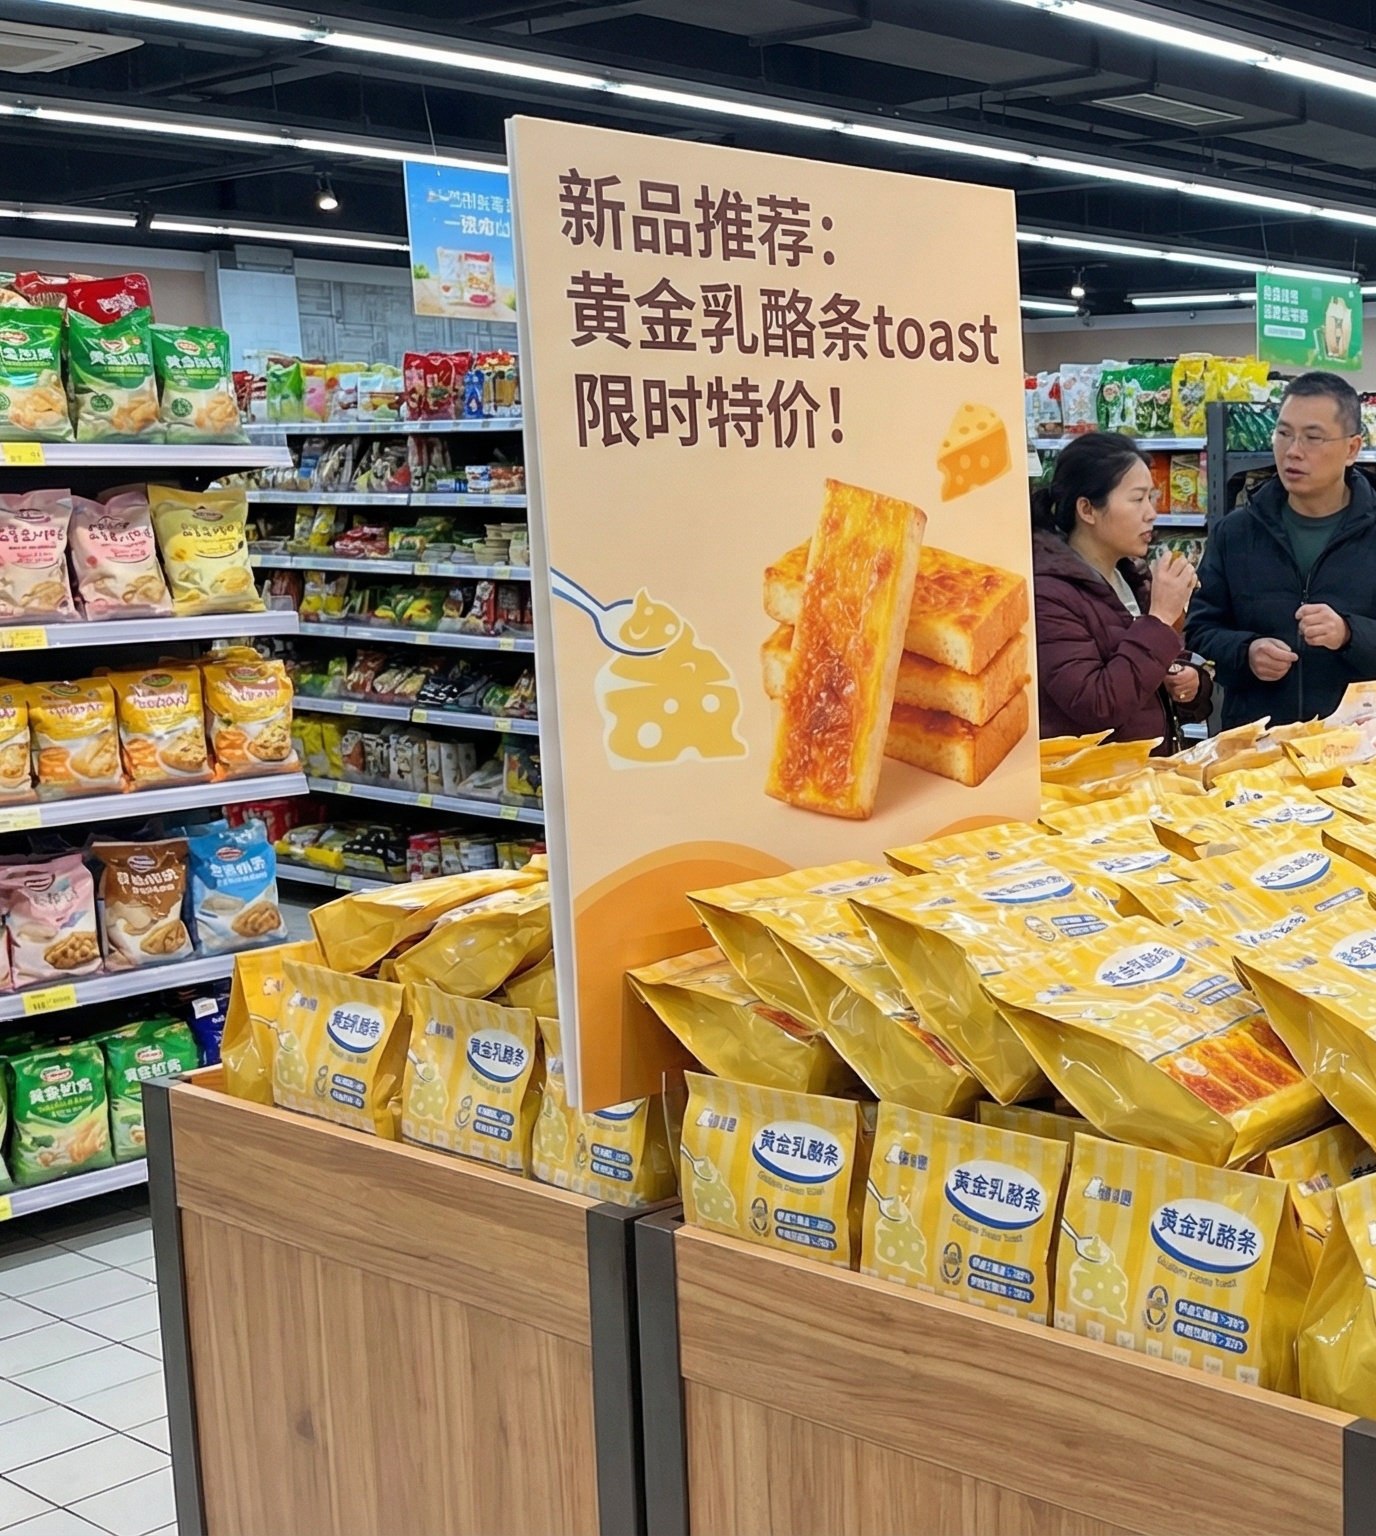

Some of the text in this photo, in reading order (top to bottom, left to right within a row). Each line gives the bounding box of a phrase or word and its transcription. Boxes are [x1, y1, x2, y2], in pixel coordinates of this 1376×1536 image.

[566, 270, 1000, 365] 黄金乳酪条toast
[953, 1169, 1041, 1212] 黄金乳酪条
[1159, 1207, 1257, 1256] 黄金乳酪条
